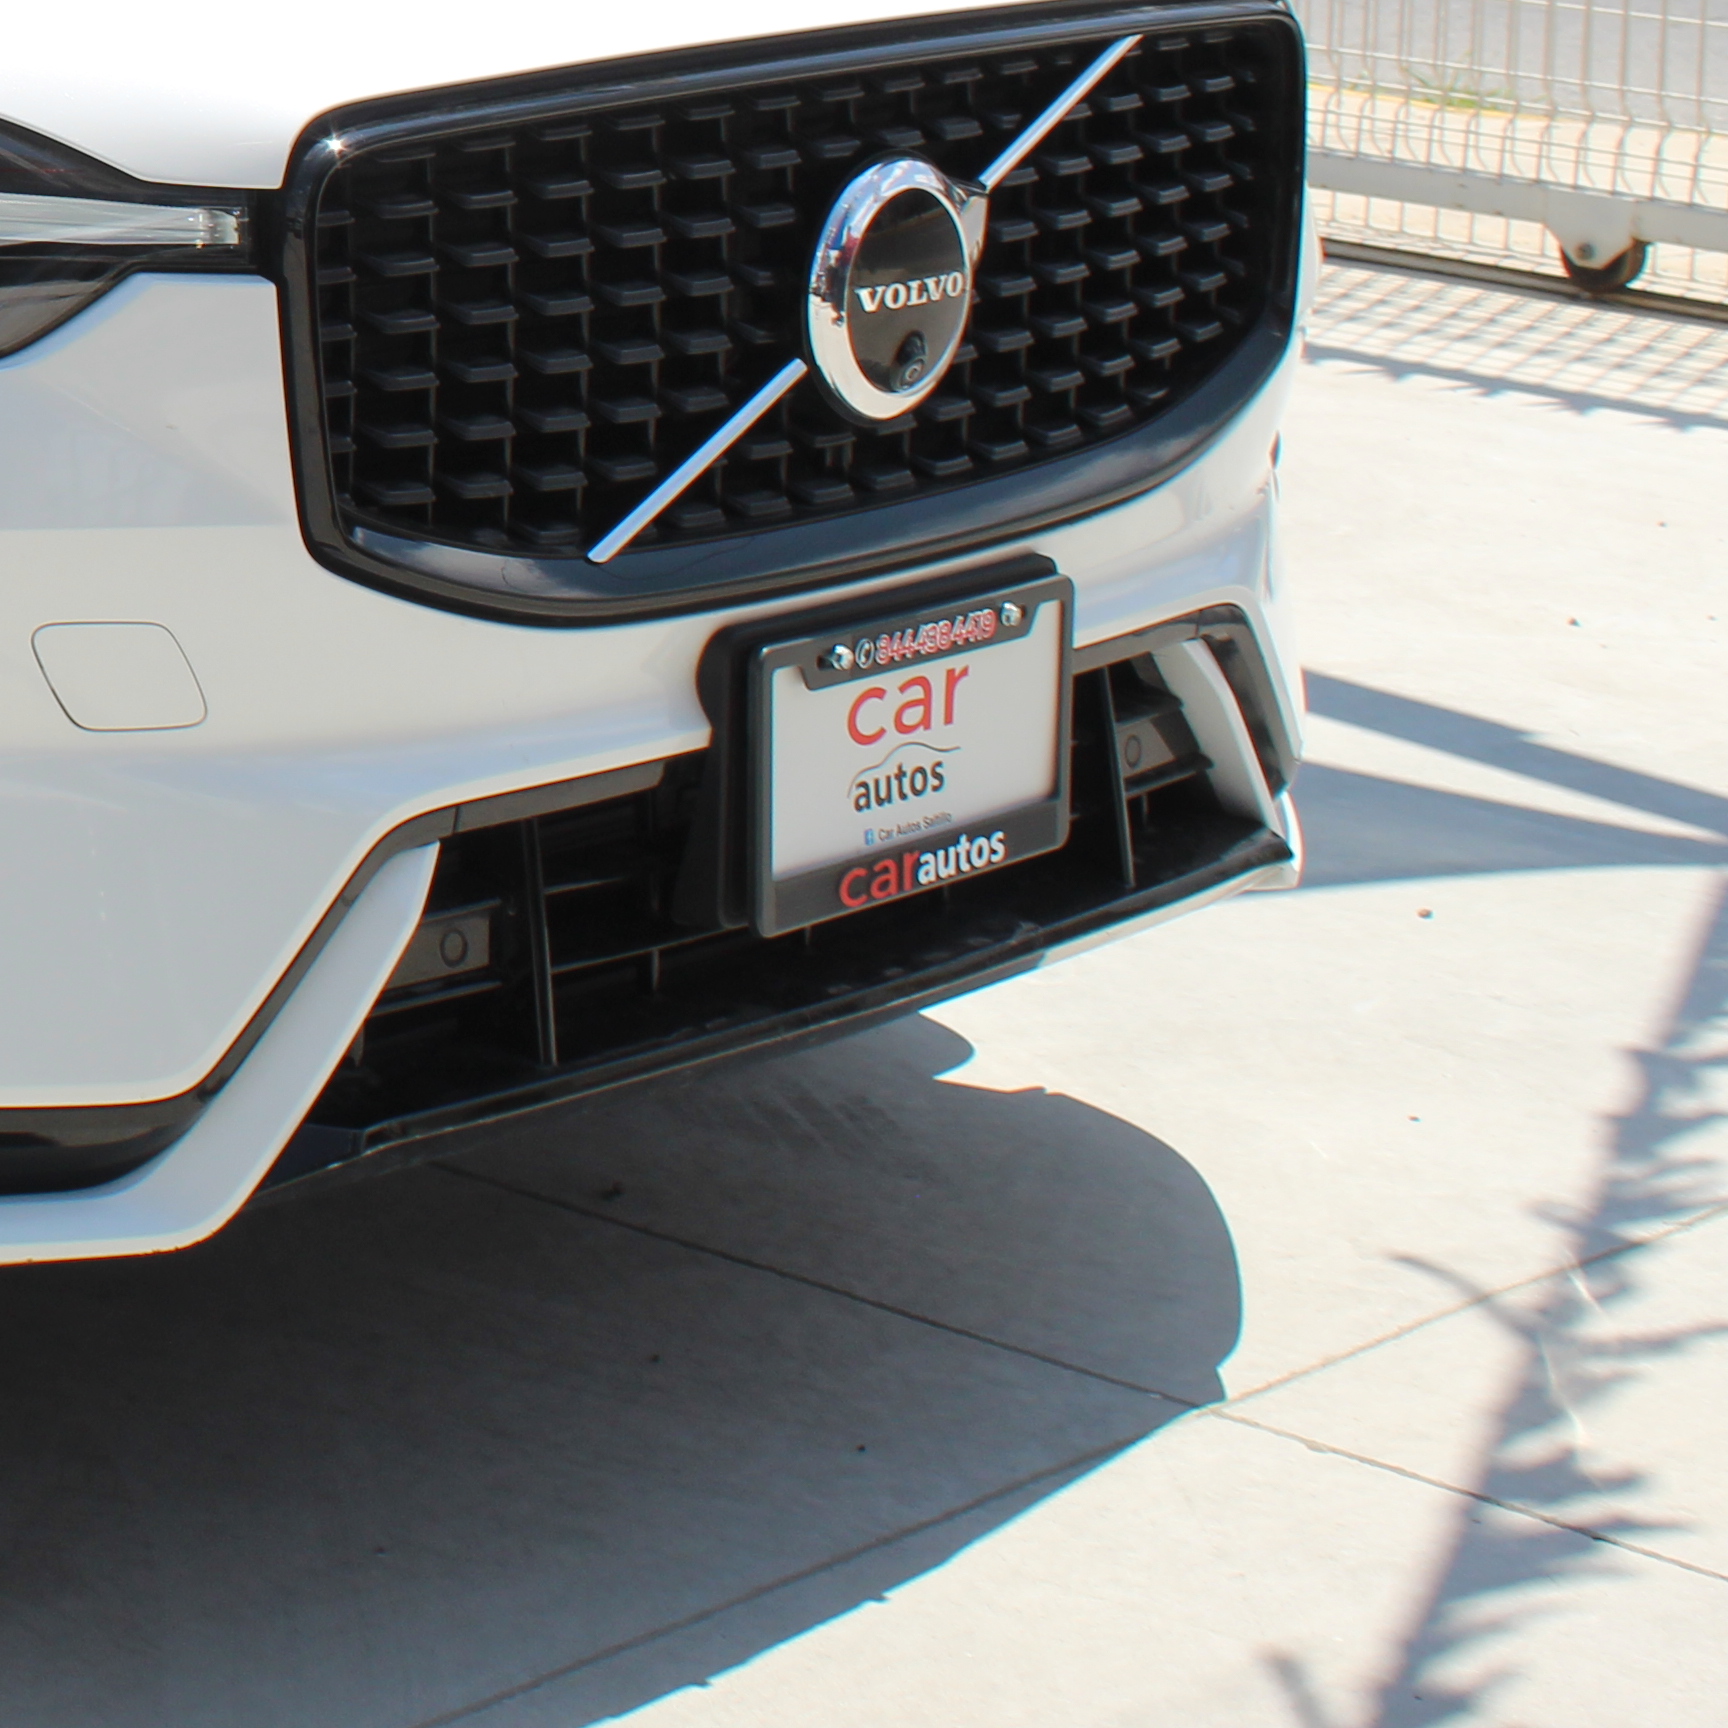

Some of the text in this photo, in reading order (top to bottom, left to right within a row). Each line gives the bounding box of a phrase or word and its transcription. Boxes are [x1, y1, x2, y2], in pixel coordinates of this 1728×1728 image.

[854, 270, 965, 314] VOLVO
[846, 664, 970, 746] car
[851, 759, 946, 813] autos
